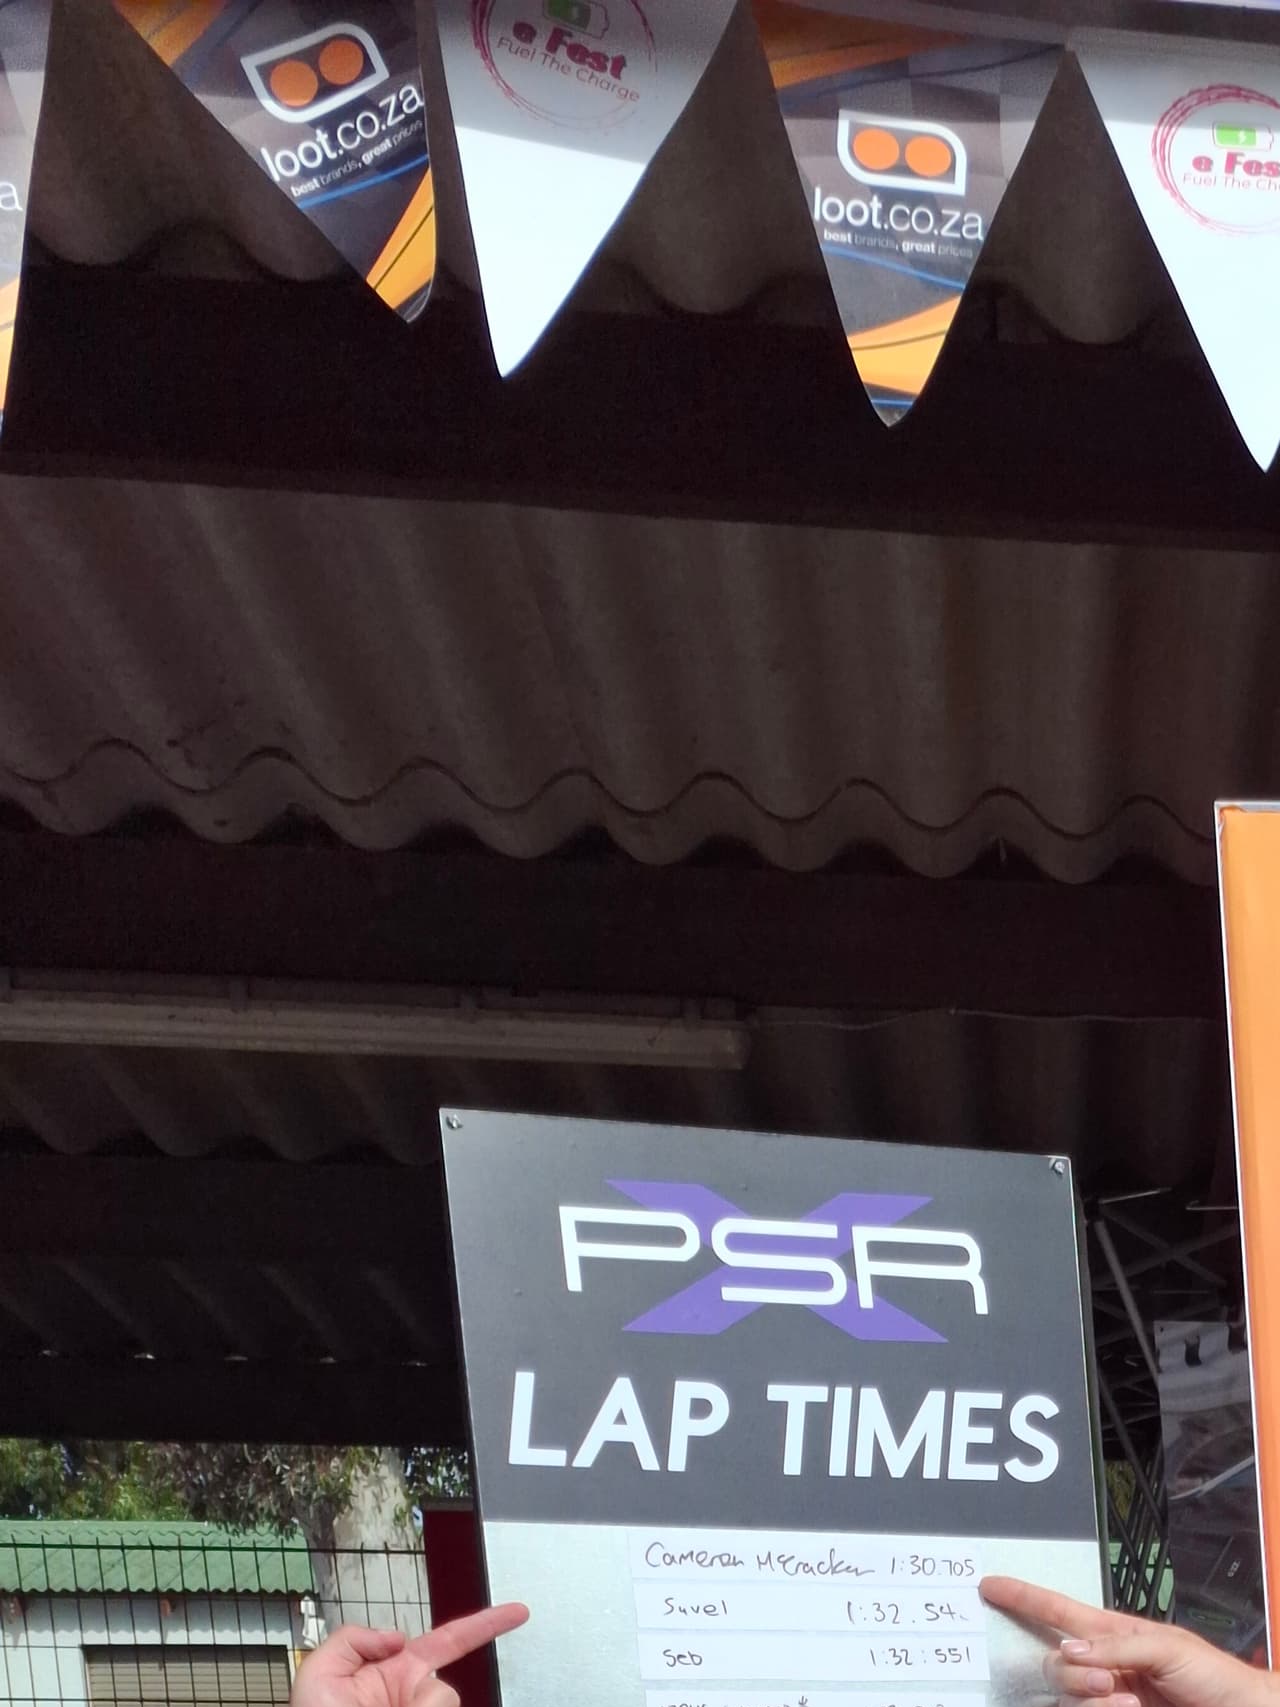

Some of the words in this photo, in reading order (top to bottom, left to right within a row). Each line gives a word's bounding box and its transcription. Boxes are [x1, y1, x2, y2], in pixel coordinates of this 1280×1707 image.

[540, 52, 572, 75] The
[575, 68, 640, 102] Charge
[260, 84, 425, 182] loot.co.za
[813, 185, 985, 241] loot.co.za
[559, 1205, 989, 1315] PSR
[508, 1371, 730, 1472] LAP
[766, 1383, 1061, 1482] TIMES
[645, 1541, 744, 1568] Cameron
[662, 1649, 703, 1668] Seb
